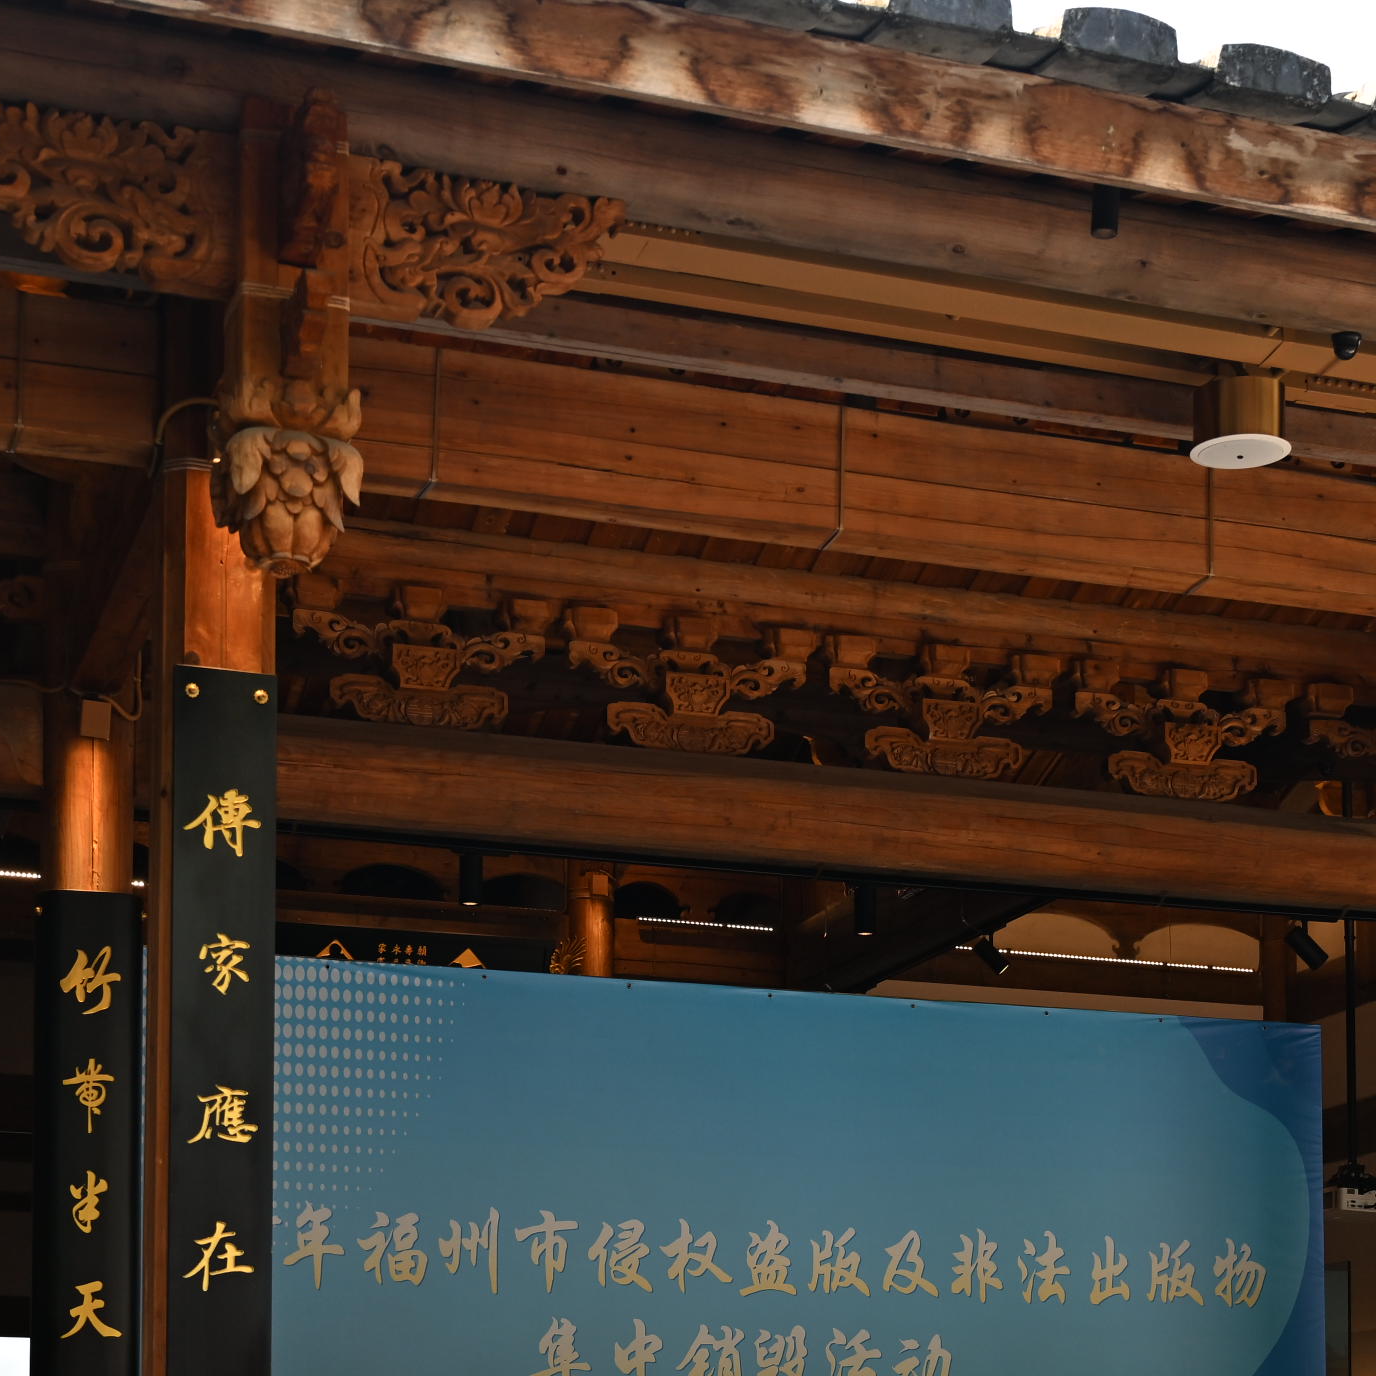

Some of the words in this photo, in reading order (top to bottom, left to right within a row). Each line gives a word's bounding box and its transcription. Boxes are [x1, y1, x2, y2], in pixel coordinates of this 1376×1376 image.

[278, 1200, 1267, 1308] 年福州市侵权盗版及非法出版物
